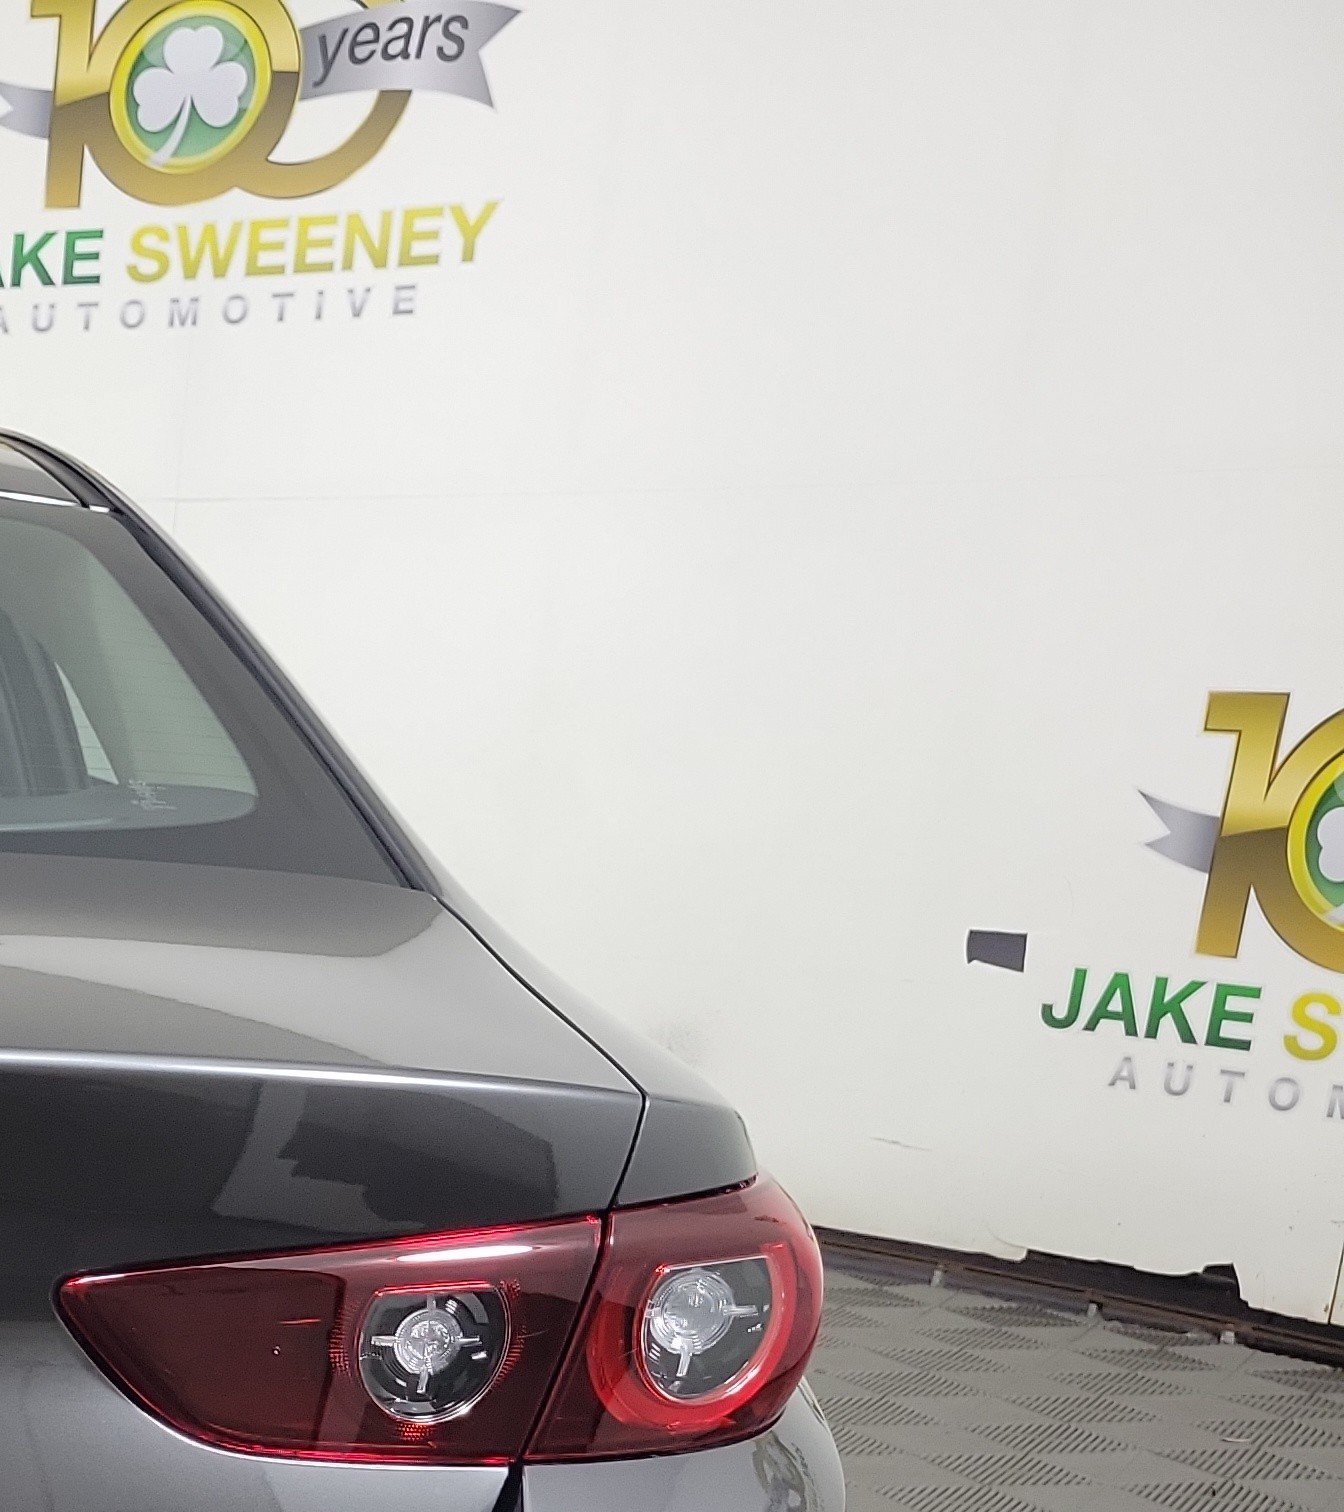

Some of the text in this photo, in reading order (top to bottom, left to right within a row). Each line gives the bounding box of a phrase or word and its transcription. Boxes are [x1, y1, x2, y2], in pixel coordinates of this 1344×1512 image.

[311, 11, 470, 88] years
[125, 201, 501, 285] SWEENEY
[1040, 966, 1264, 1052] JAKE
